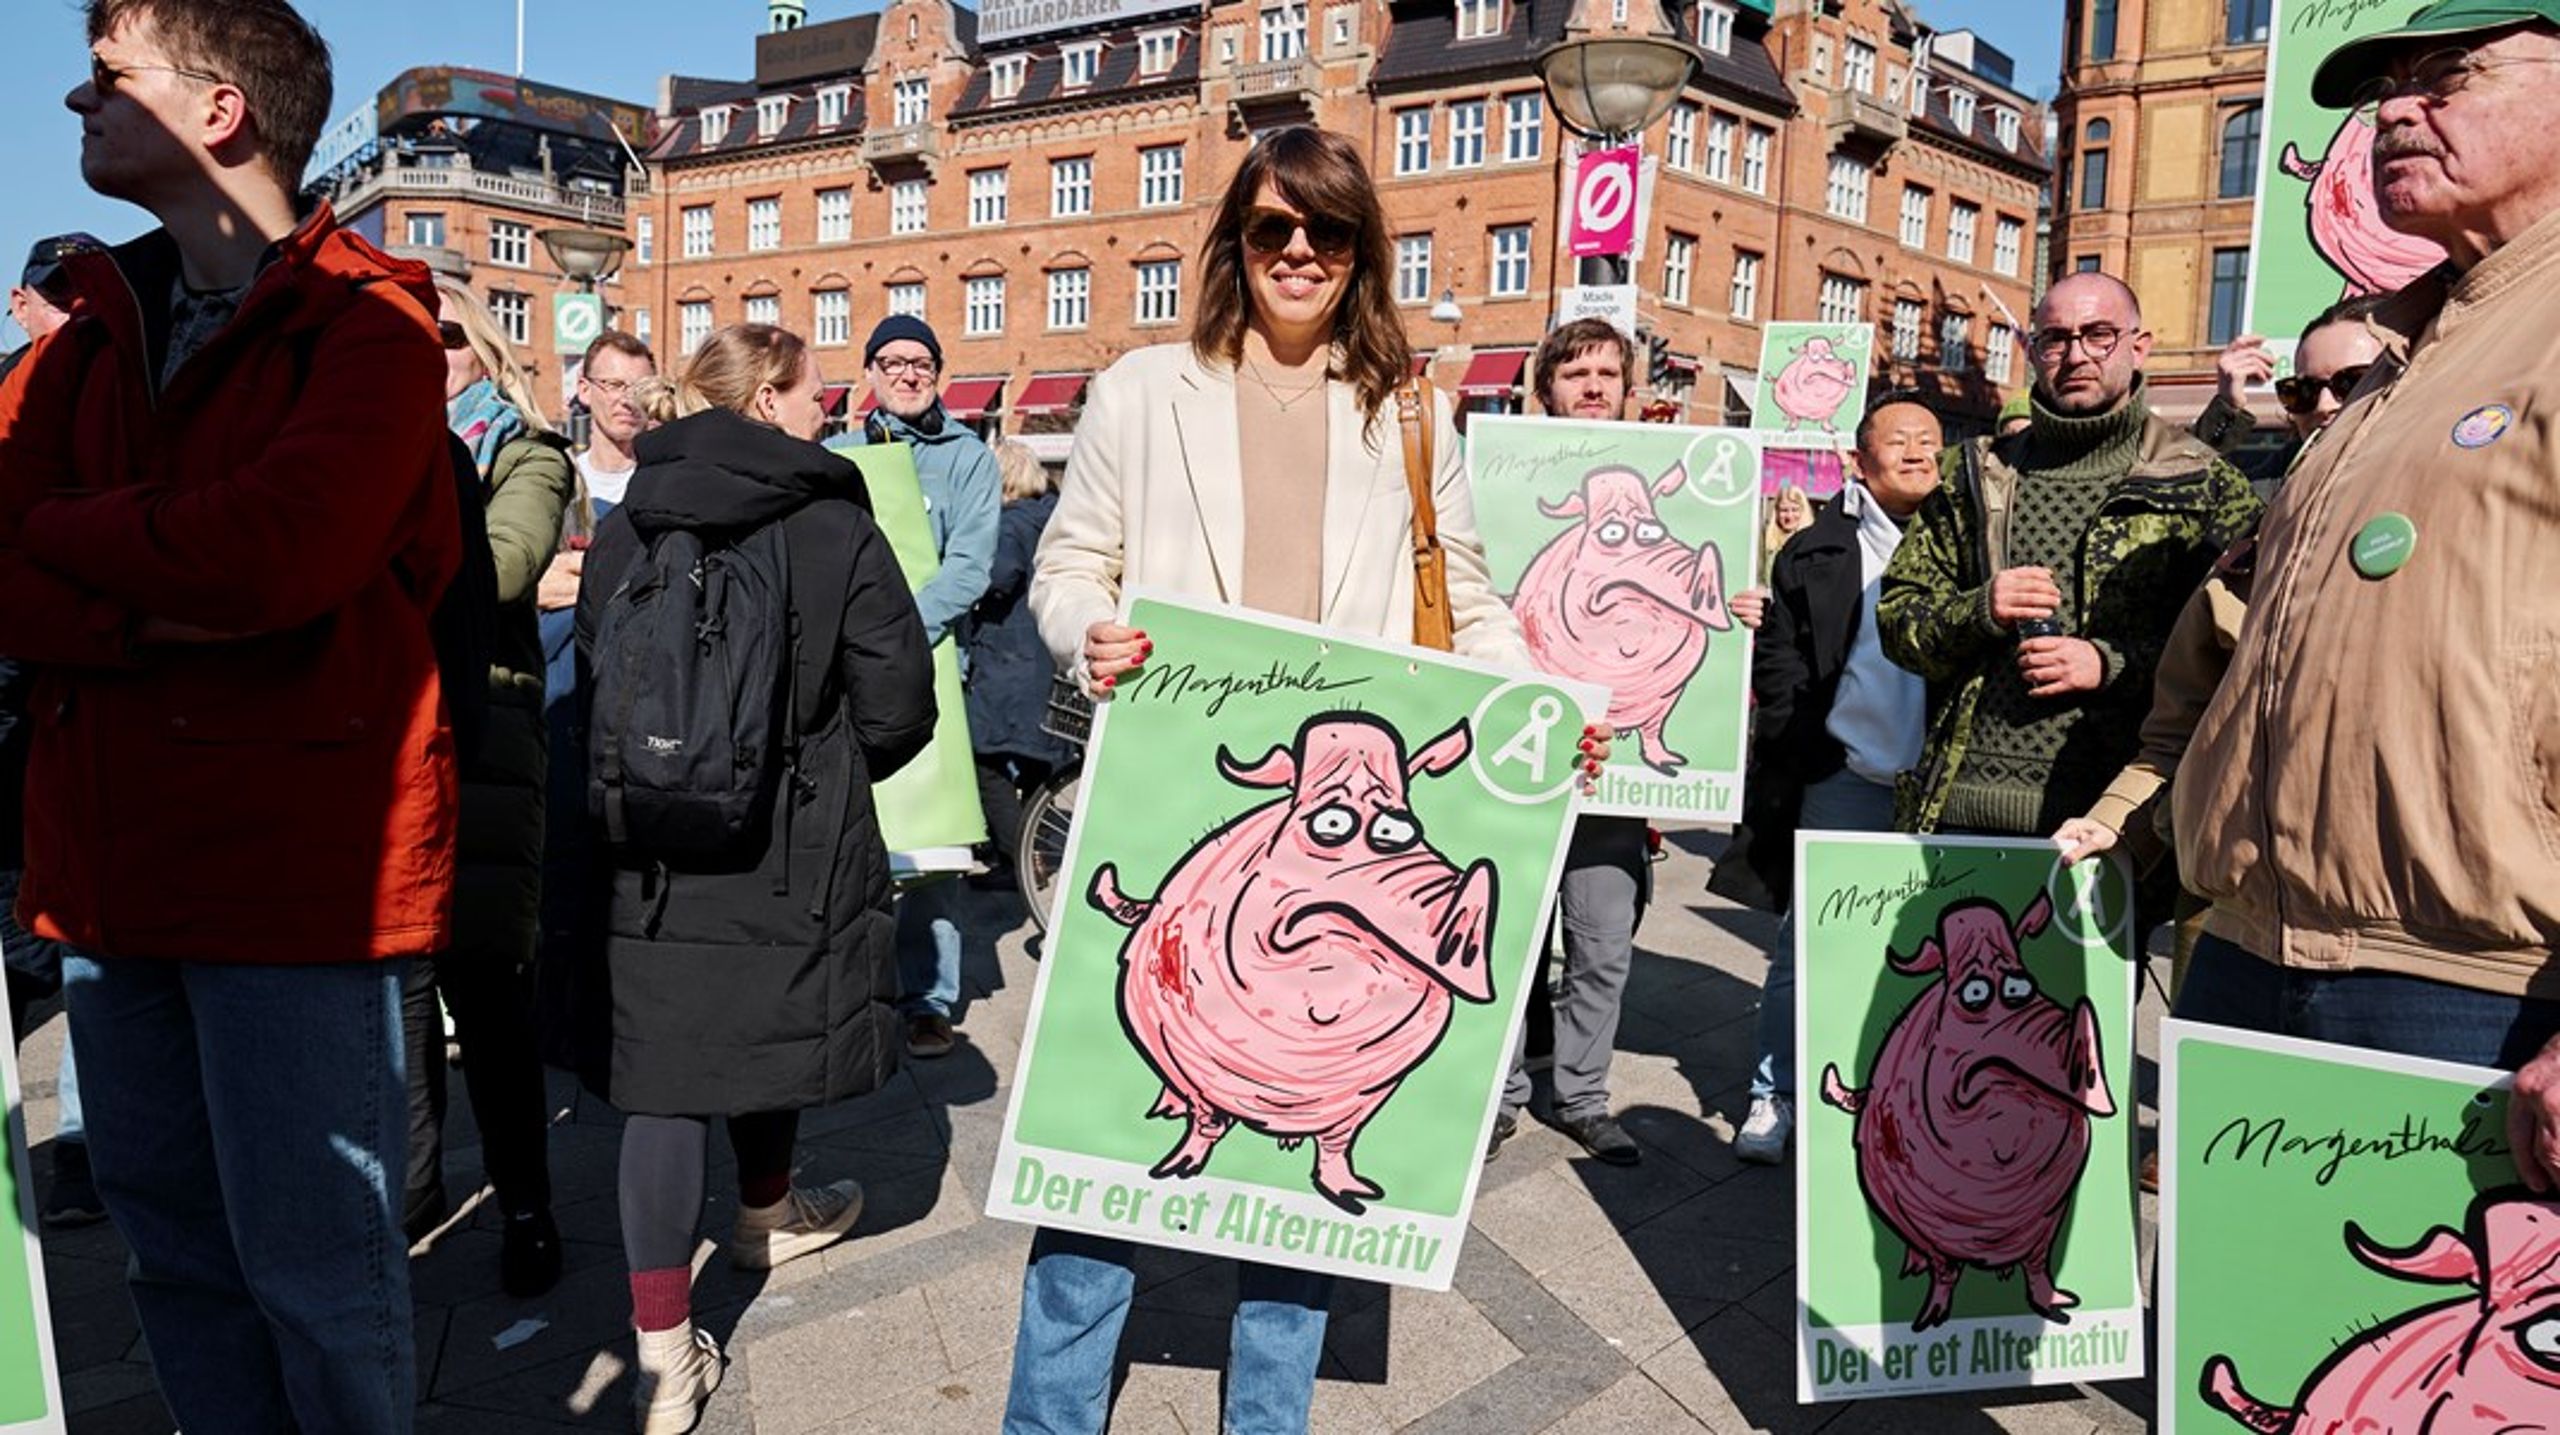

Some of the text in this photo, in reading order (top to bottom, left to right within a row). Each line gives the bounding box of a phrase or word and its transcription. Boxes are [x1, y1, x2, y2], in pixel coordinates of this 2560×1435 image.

[1490, 695, 1564, 784] Å
[1011, 1156, 1094, 1214] Der
[1101, 1183, 1152, 1225] er
[1160, 1190, 1211, 1235] et
[1215, 1192, 1442, 1273] Alternativ
[1816, 1320, 2129, 1385] Der er et Alternativ
